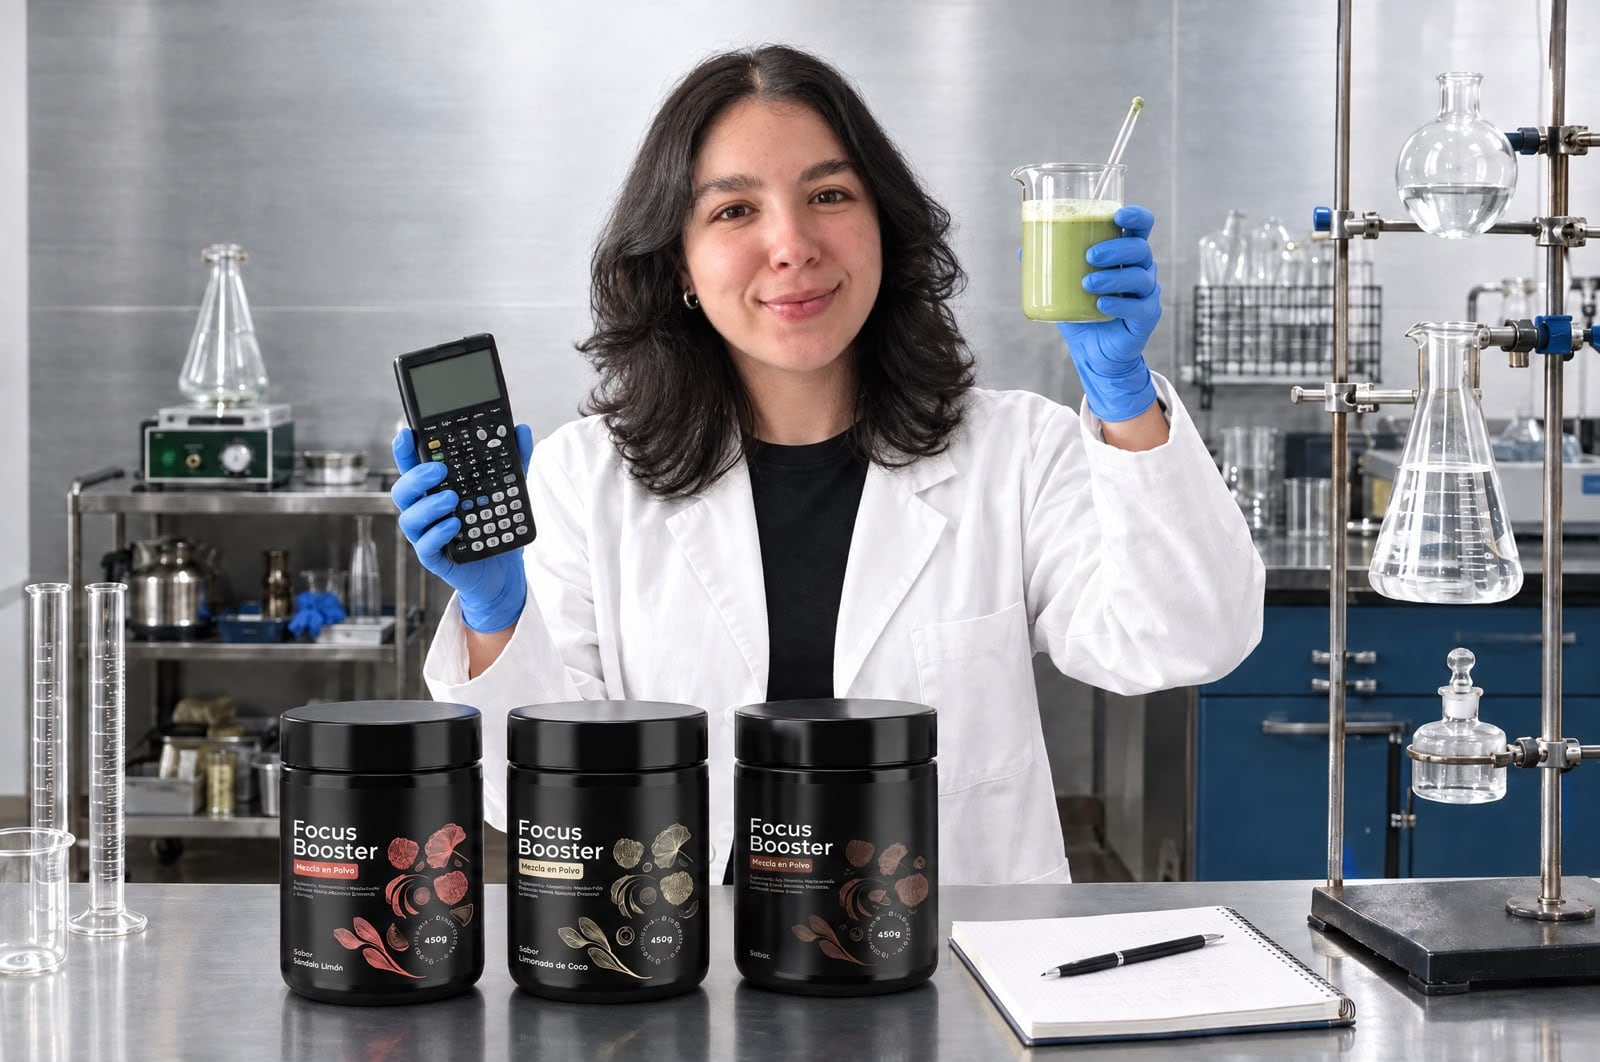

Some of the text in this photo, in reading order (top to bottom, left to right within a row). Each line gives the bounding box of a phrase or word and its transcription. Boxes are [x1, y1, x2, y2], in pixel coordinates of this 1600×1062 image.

[293, 819, 357, 841] Focus
[518, 819, 583, 841] Focus
[750, 816, 813, 837] Focus
[293, 838, 379, 860] Booster
[518, 837, 604, 860] Booster
[750, 834, 834, 856] Booster
[296, 863, 355, 875] Mezcla en Polvo
[521, 863, 581, 875] Mezcla en Polvo
[752, 858, 811, 870] Mezcla en Polvo
[424, 935, 448, 945] 450g
[650, 935, 674, 944] 450g
[877, 930, 901, 939] 450g
[293, 948, 314, 958] Sabor
[518, 945, 539, 956] Sabor
[320, 962, 344, 972] Limón
[518, 954, 589, 971] Limonada de Coco
